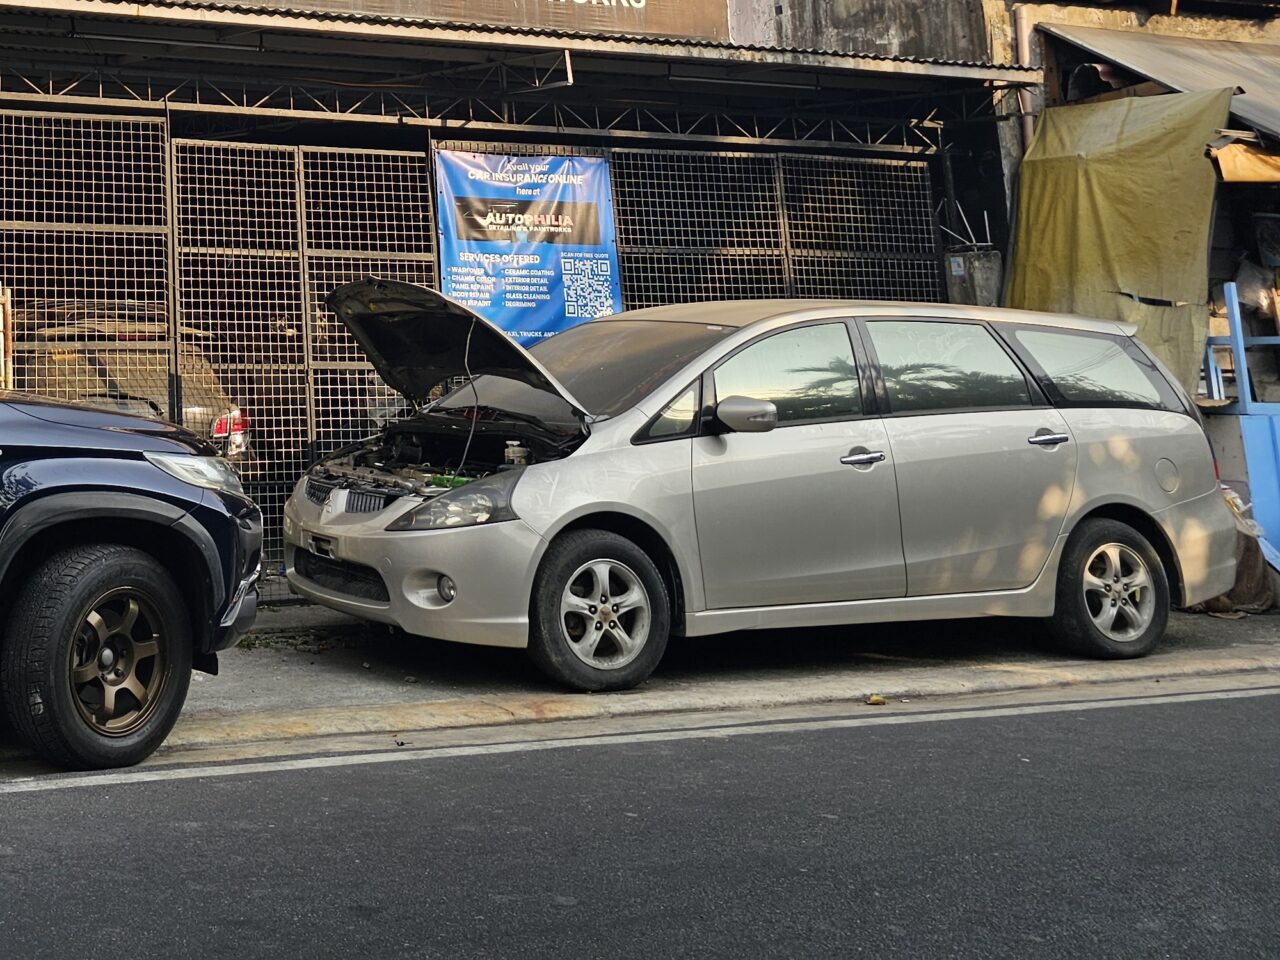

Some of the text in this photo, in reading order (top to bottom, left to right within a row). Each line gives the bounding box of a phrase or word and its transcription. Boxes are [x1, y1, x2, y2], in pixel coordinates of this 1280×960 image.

[530, 164, 549, 173] your
[468, 170, 584, 184] CAR INSURANCE ONLINE
[516, 187, 532, 195] here
[486, 212, 574, 226] AUTOPHILIA
[459, 252, 540, 264] SERVICES OFFERED
